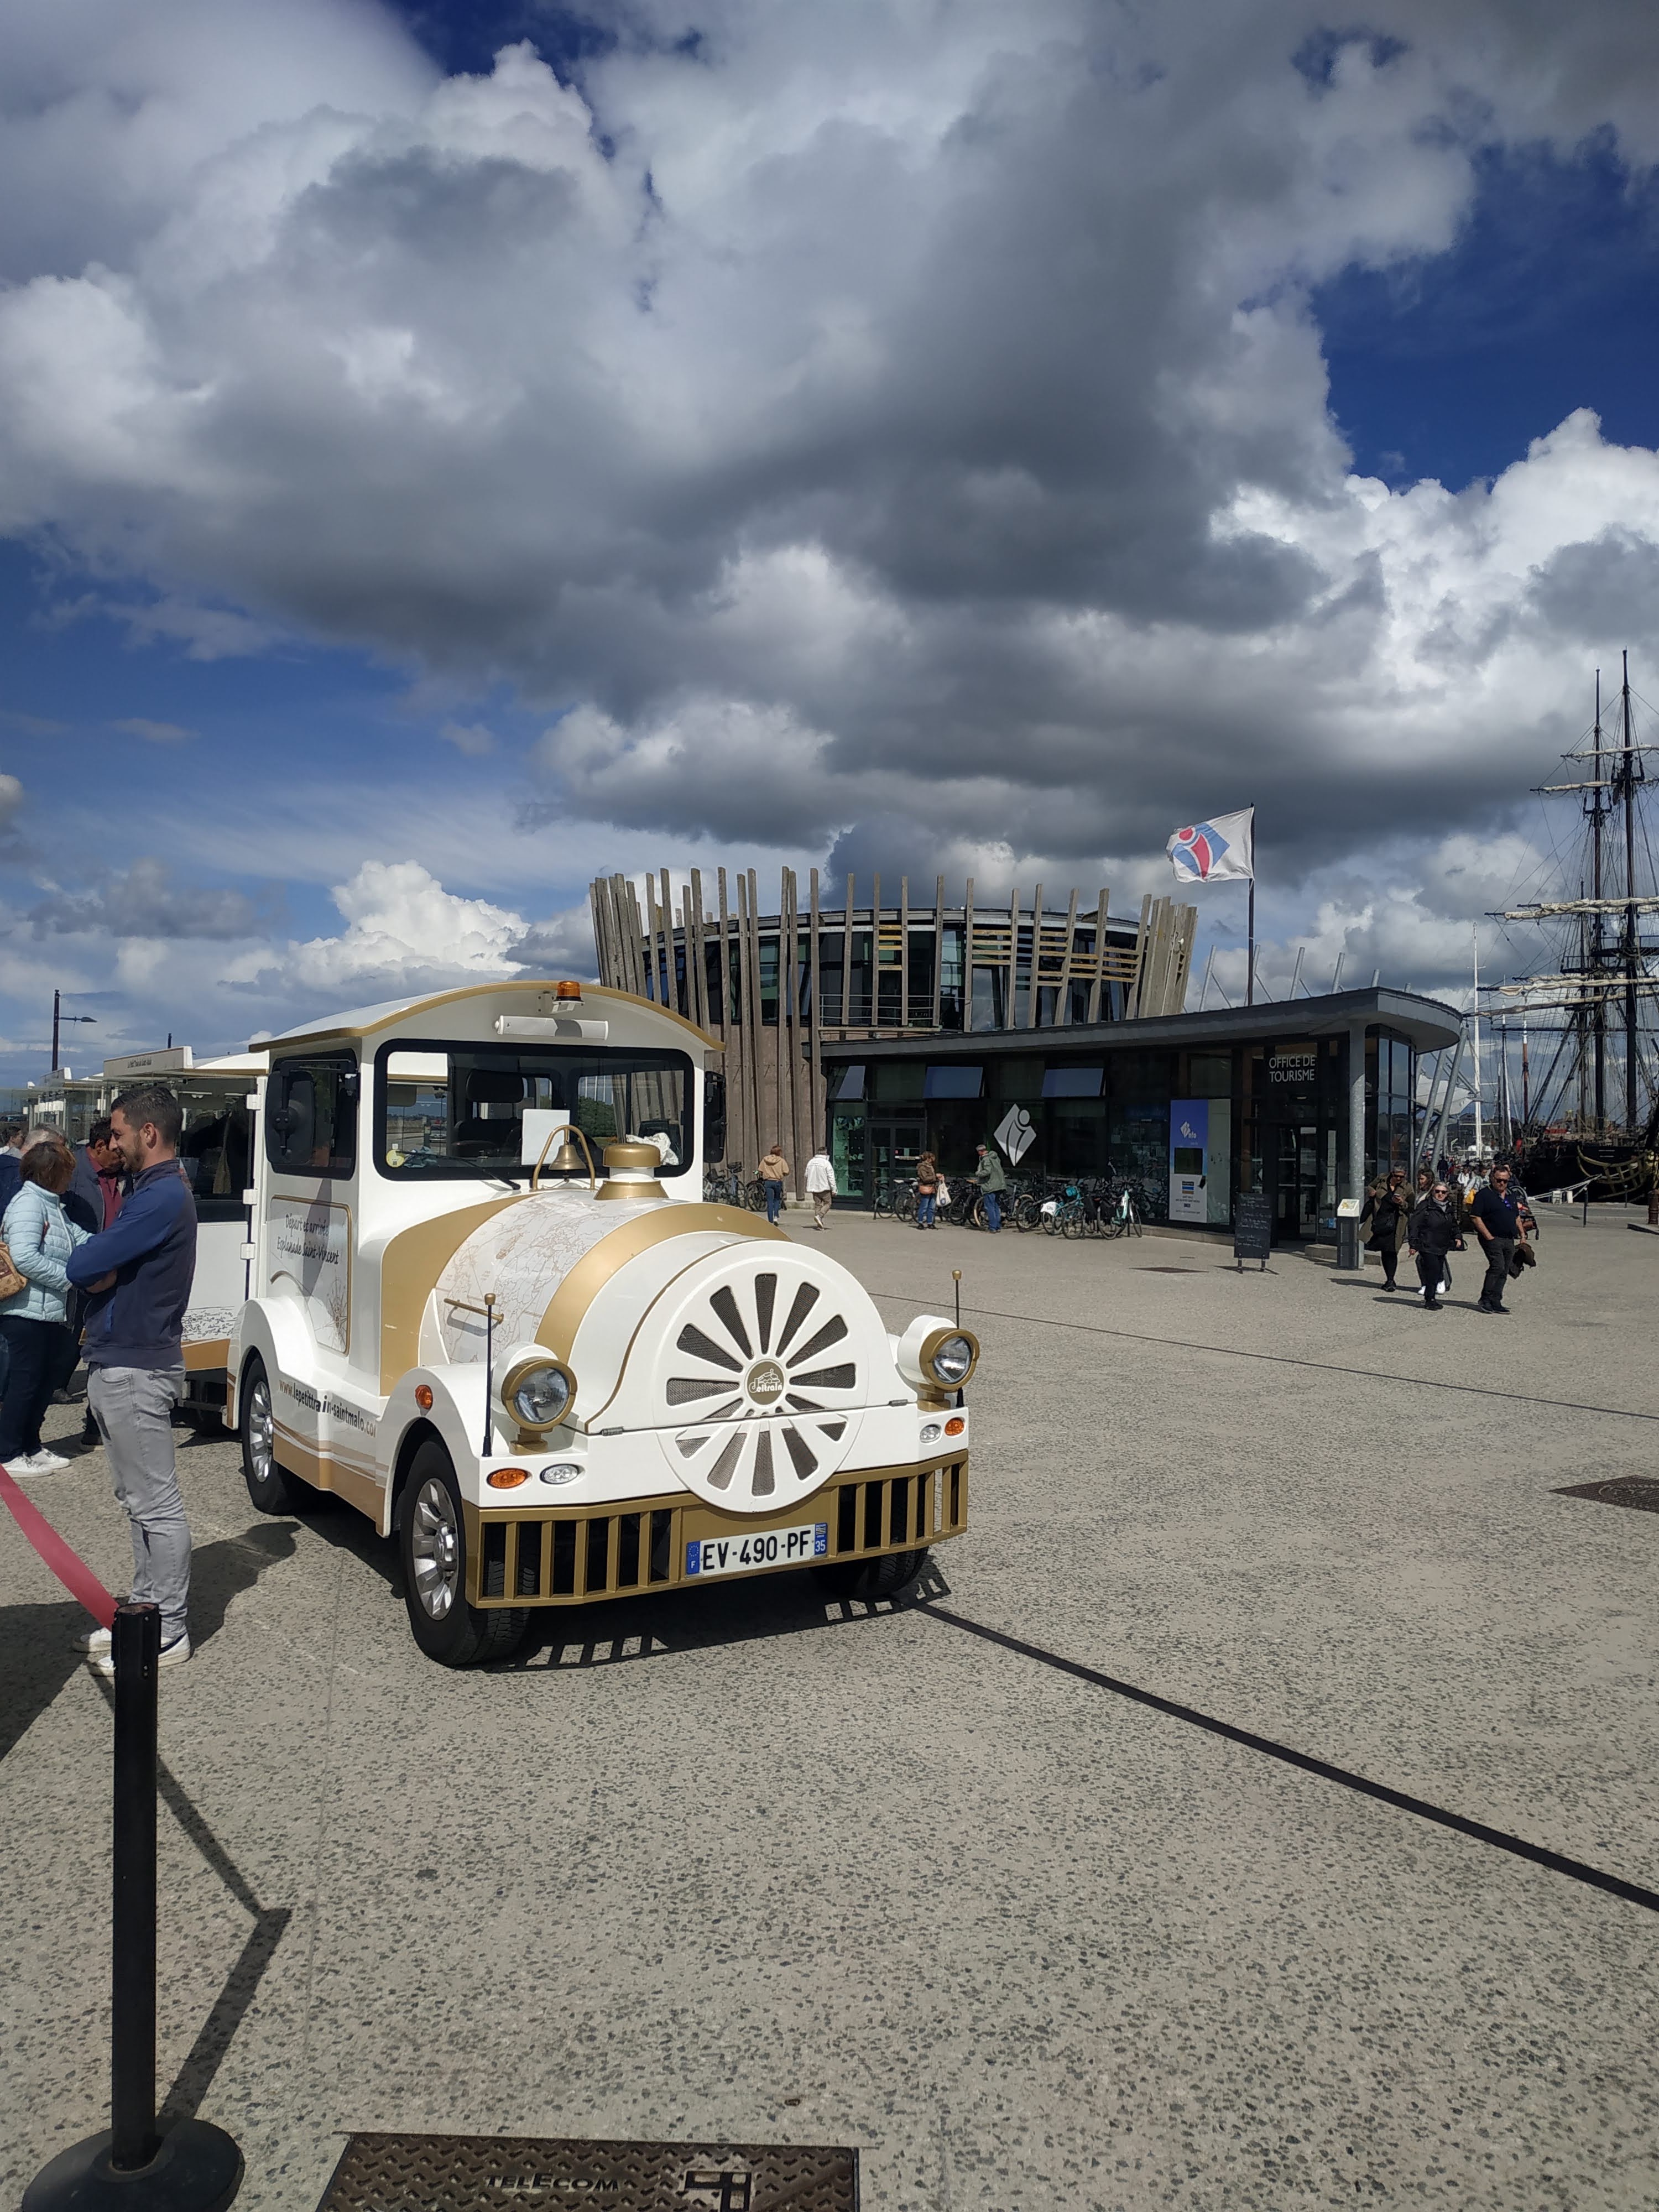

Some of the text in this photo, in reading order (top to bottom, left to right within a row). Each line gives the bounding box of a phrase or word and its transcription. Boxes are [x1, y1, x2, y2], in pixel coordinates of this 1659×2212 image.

[1269, 1055, 1316, 1068] OFFICE DE
[1269, 1069, 1315, 1083] TOURISME
[285, 1213, 302, 1237] Départ
[303, 1218, 309, 1233] et
[276, 1235, 339, 1265] Esplanade Saint-Vincent
[691, 1530, 826, 1571] F EV-490-PF 35
[486, 2172, 619, 2192] TELECOM
